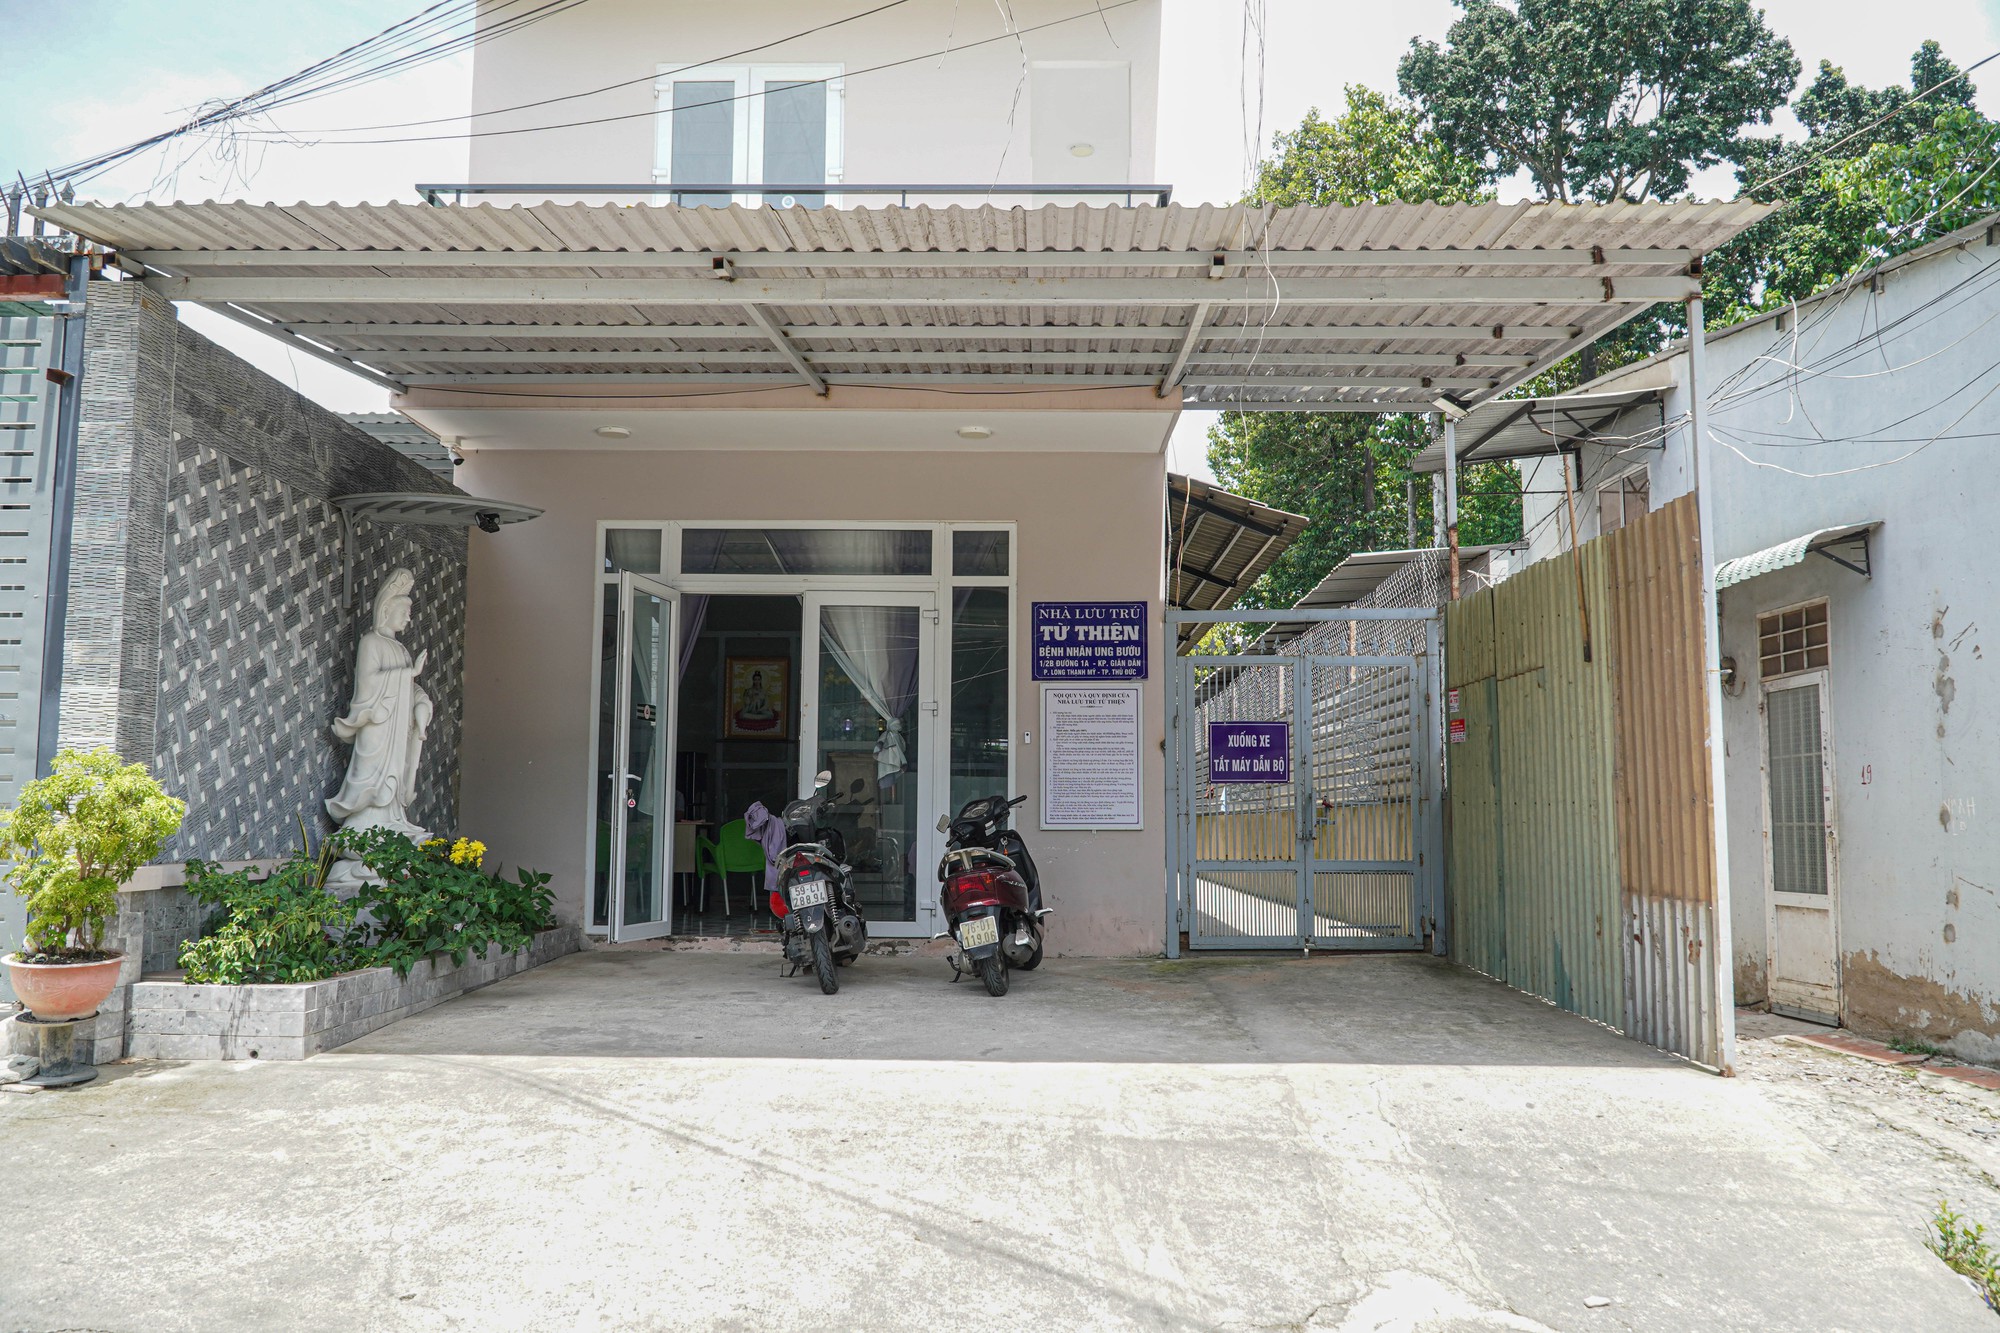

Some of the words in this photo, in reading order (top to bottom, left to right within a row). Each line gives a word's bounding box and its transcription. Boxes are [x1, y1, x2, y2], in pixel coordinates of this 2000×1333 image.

[1039, 606, 1071, 619] NHÀ
[1075, 607, 1106, 619] LƯU
[1110, 606, 1140, 619] TRÚ
[1040, 622, 1070, 641] TỪ
[1075, 622, 1139, 643] THIỆN
[1039, 645, 1063, 658] BỆNH
[1067, 645, 1092, 656] NHÂN
[1095, 647, 1113, 656] UNG
[1116, 645, 1140, 656] BƯỚU
[1056, 659, 1078, 667] ĐƯỜNG
[1067, 669, 1086, 677] THẠNH
[1228, 731, 1257, 747] XUỐNG
[1259, 735, 1270, 747] XE
[1214, 755, 1229, 772] TẮT
[1232, 756, 1250, 772] MÁY
[1253, 754, 1270, 772] DẪN
[1273, 756, 1285, 774] BỘ
[1861, 764, 1872, 785] 19
[795, 883, 820, 896] 59-C1
[793, 892, 825, 908] 288.94
[965, 930, 996, 948] 119.06
